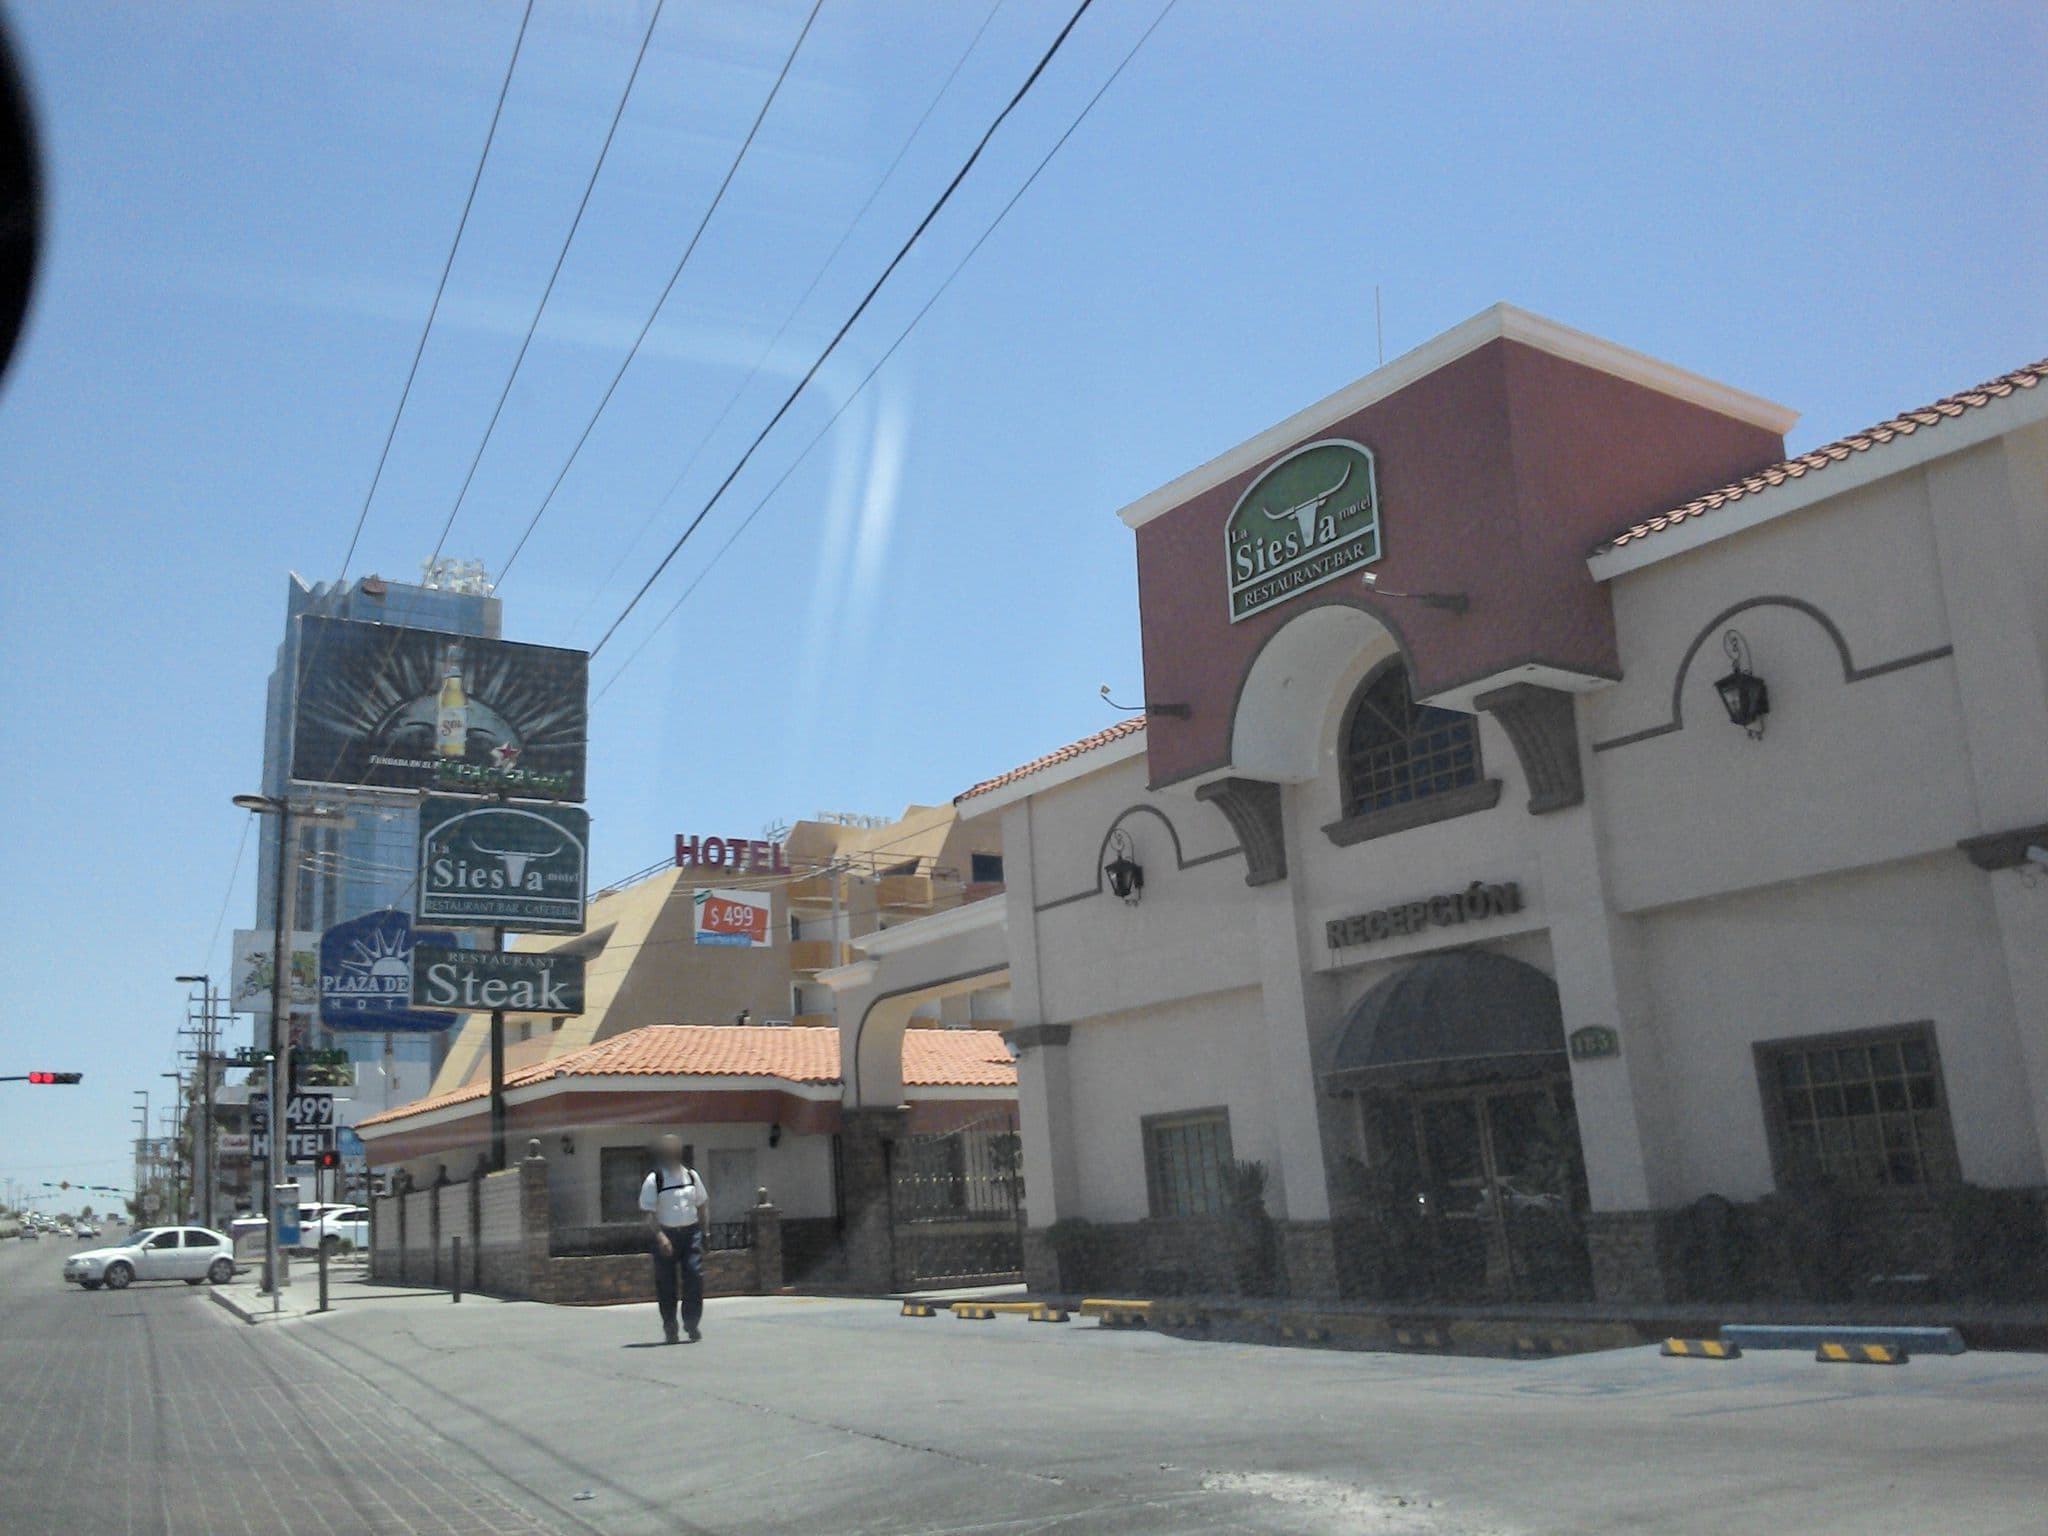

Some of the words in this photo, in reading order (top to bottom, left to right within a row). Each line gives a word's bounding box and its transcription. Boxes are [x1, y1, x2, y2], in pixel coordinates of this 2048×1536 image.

[1338, 495, 1372, 520] motel
[675, 834, 791, 875] HOTEL
[1326, 880, 1524, 949] RECEPCIÓN
[450, 952, 557, 969] RESTAURANT
[322, 976, 378, 992] PLAZA
[426, 963, 569, 1010] Steak
[331, 999, 393, 1010] HOT
[253, 1133, 325, 1156] HTEL
